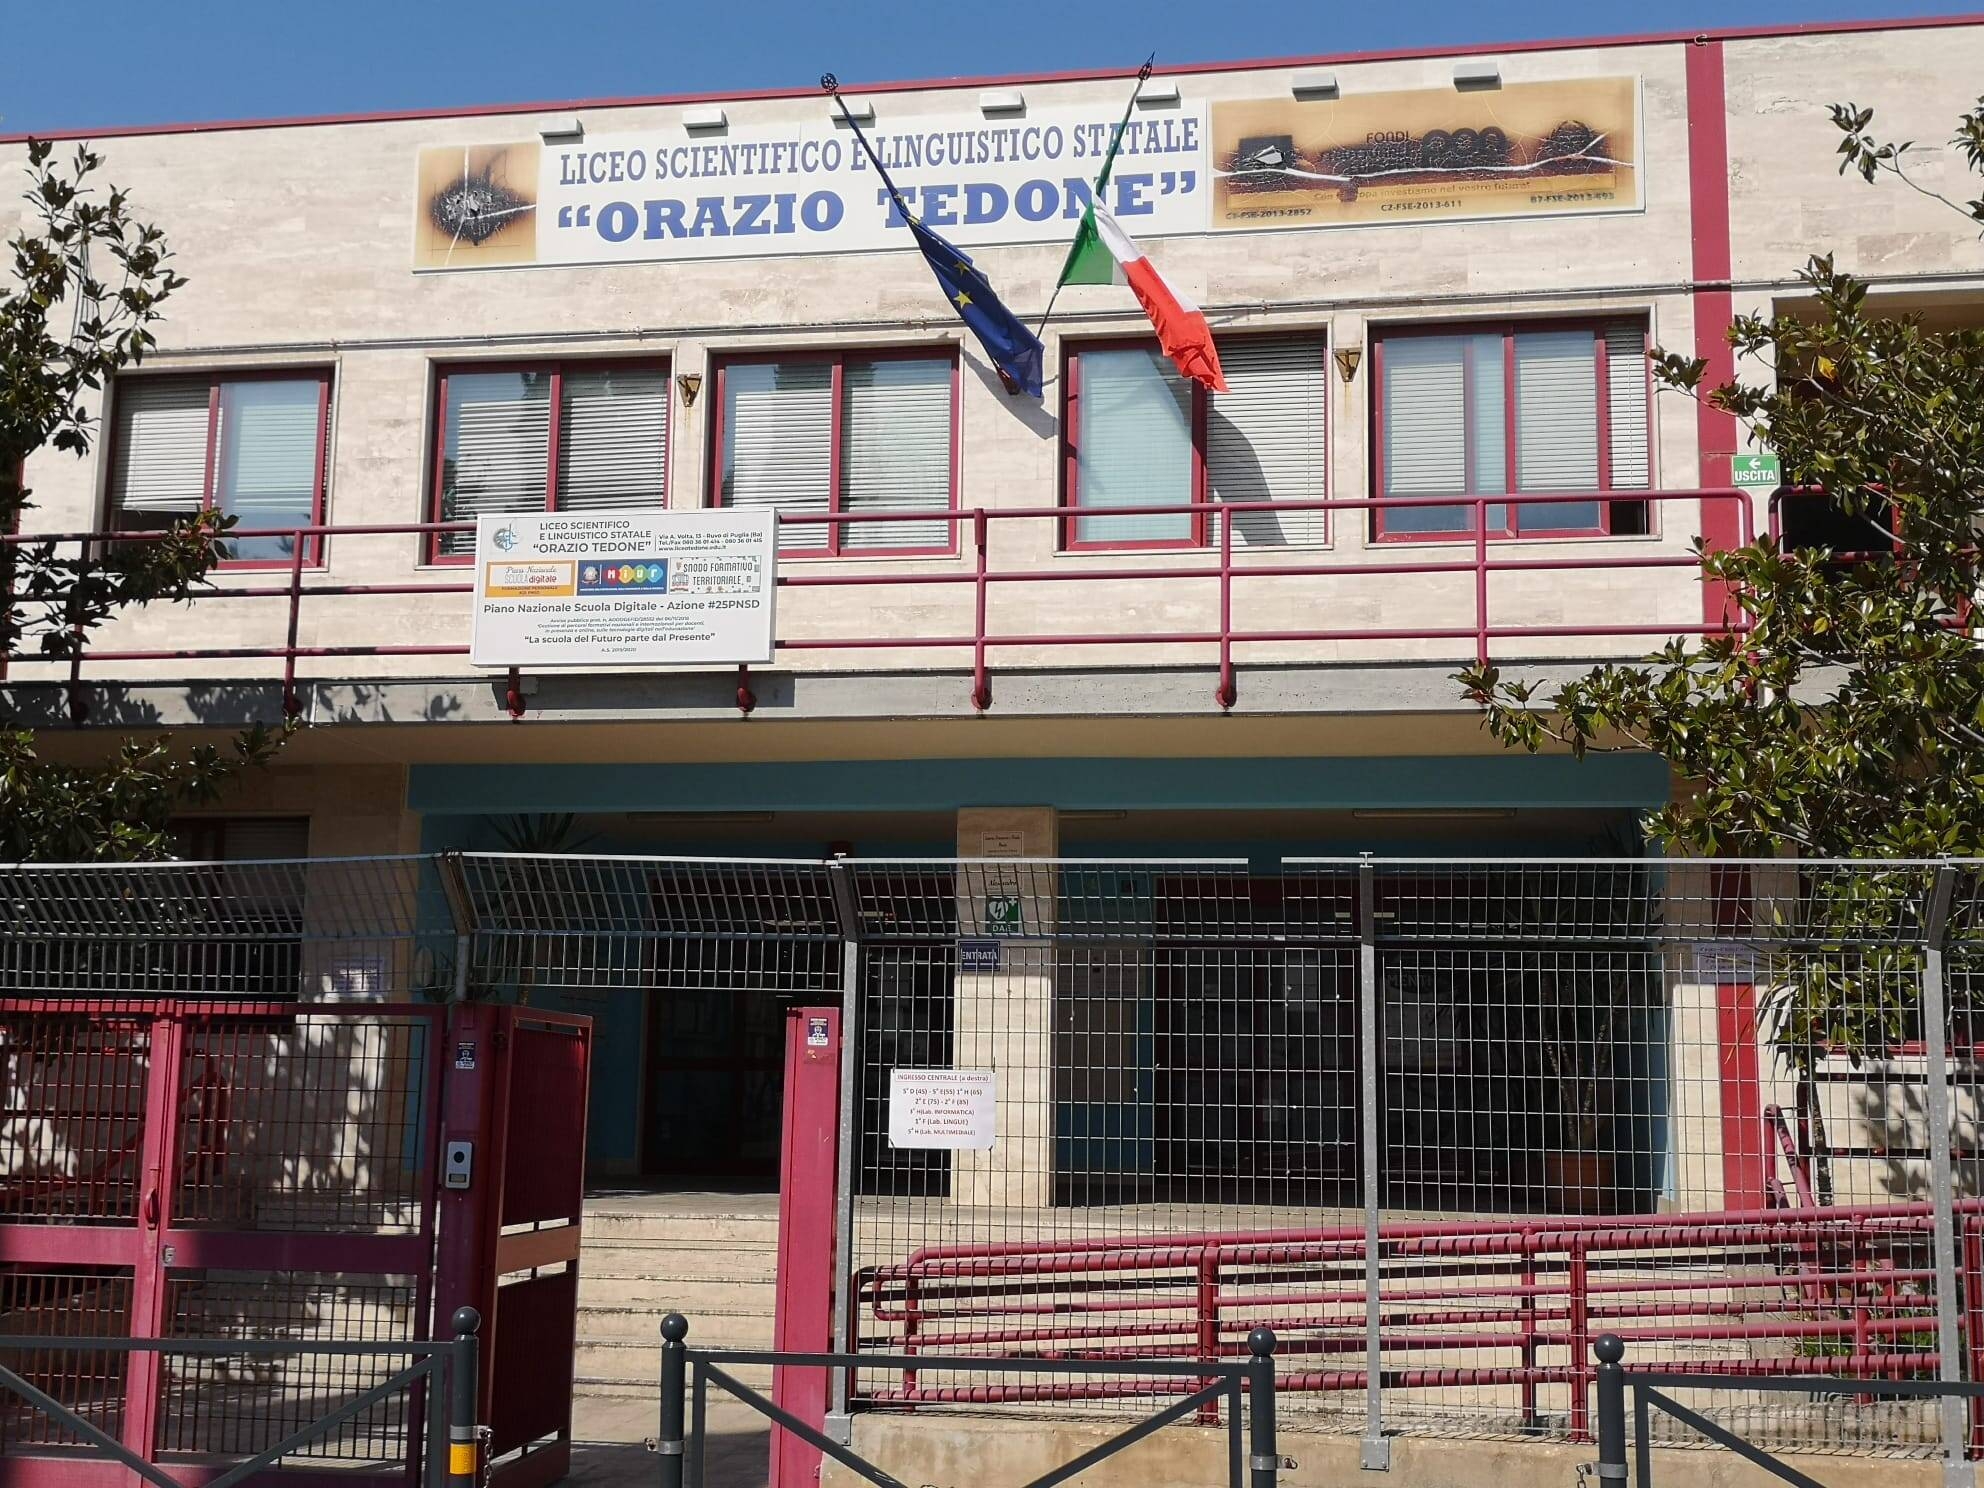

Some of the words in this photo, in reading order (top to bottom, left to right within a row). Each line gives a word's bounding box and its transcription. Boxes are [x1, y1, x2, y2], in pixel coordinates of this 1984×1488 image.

[1366, 131, 1409, 145] FONDI
[560, 149, 647, 186] LICEO
[655, 139, 842, 180] SCIENTIFICO
[850, 137, 868, 171] E
[875, 125, 1064, 169] LINGUISTICO
[1072, 117, 1200, 158] STATALE
[1734, 469, 1776, 482] USCITA
[540, 522, 567, 531] LICEO
[570, 520, 630, 530] SCIENTIFICO
[539, 533, 545, 541] E
[548, 532, 608, 540] LINGUISTICO
[611, 530, 652, 539] STATALE
[483, 603, 515, 613] Piano
[518, 603, 572, 613] Nazionale
[574, 602, 611, 612] Scuola
[614, 601, 657, 613] Digitale
[667, 600, 705, 610] Azione
[708, 599, 760, 609] #25PNSD
[542, 635, 571, 643] scuola
[574, 635, 588, 643] del
[591, 634, 622, 643] Futuro
[624, 634, 654, 643] parte
[655, 633, 666, 642] dal
[961, 951, 998, 961] ENTRATA
